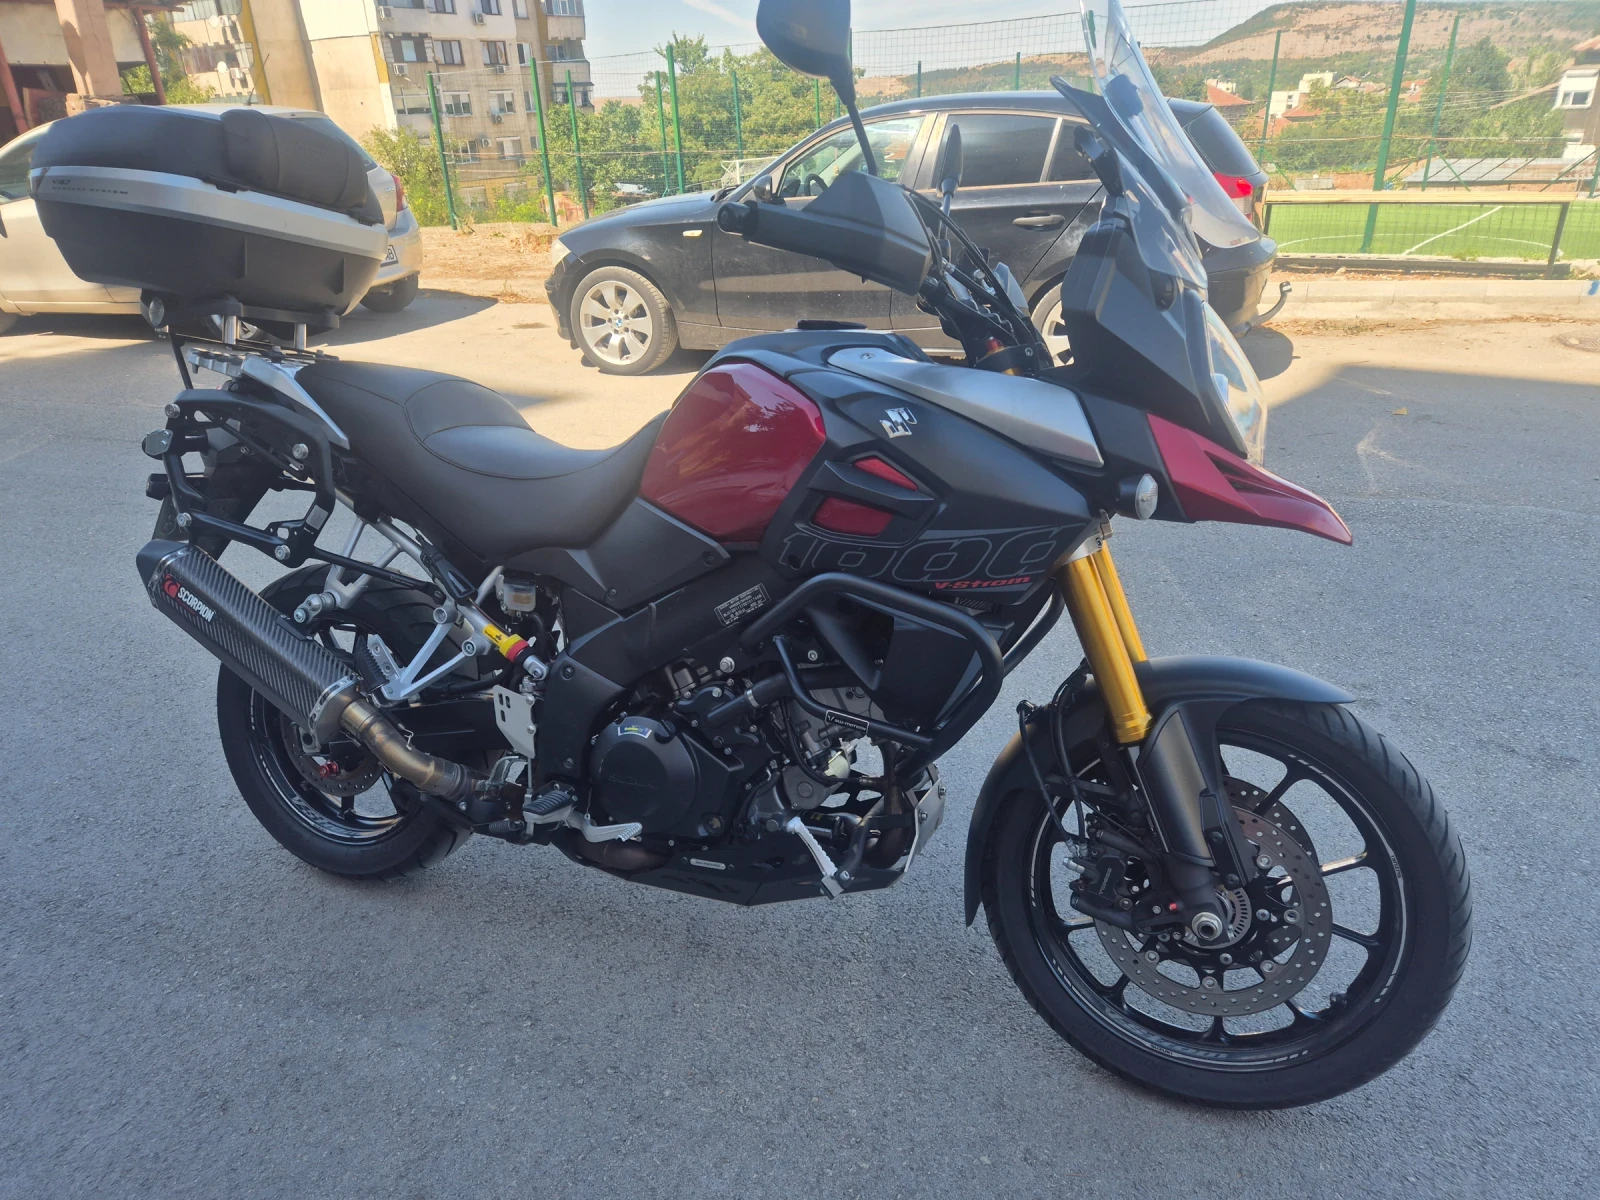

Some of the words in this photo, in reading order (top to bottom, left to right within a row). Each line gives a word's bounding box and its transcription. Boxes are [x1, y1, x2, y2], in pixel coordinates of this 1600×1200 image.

[778, 523, 1087, 582] 1000
[935, 576, 1031, 590] V-Strom
[177, 587, 215, 623] SCORPION
